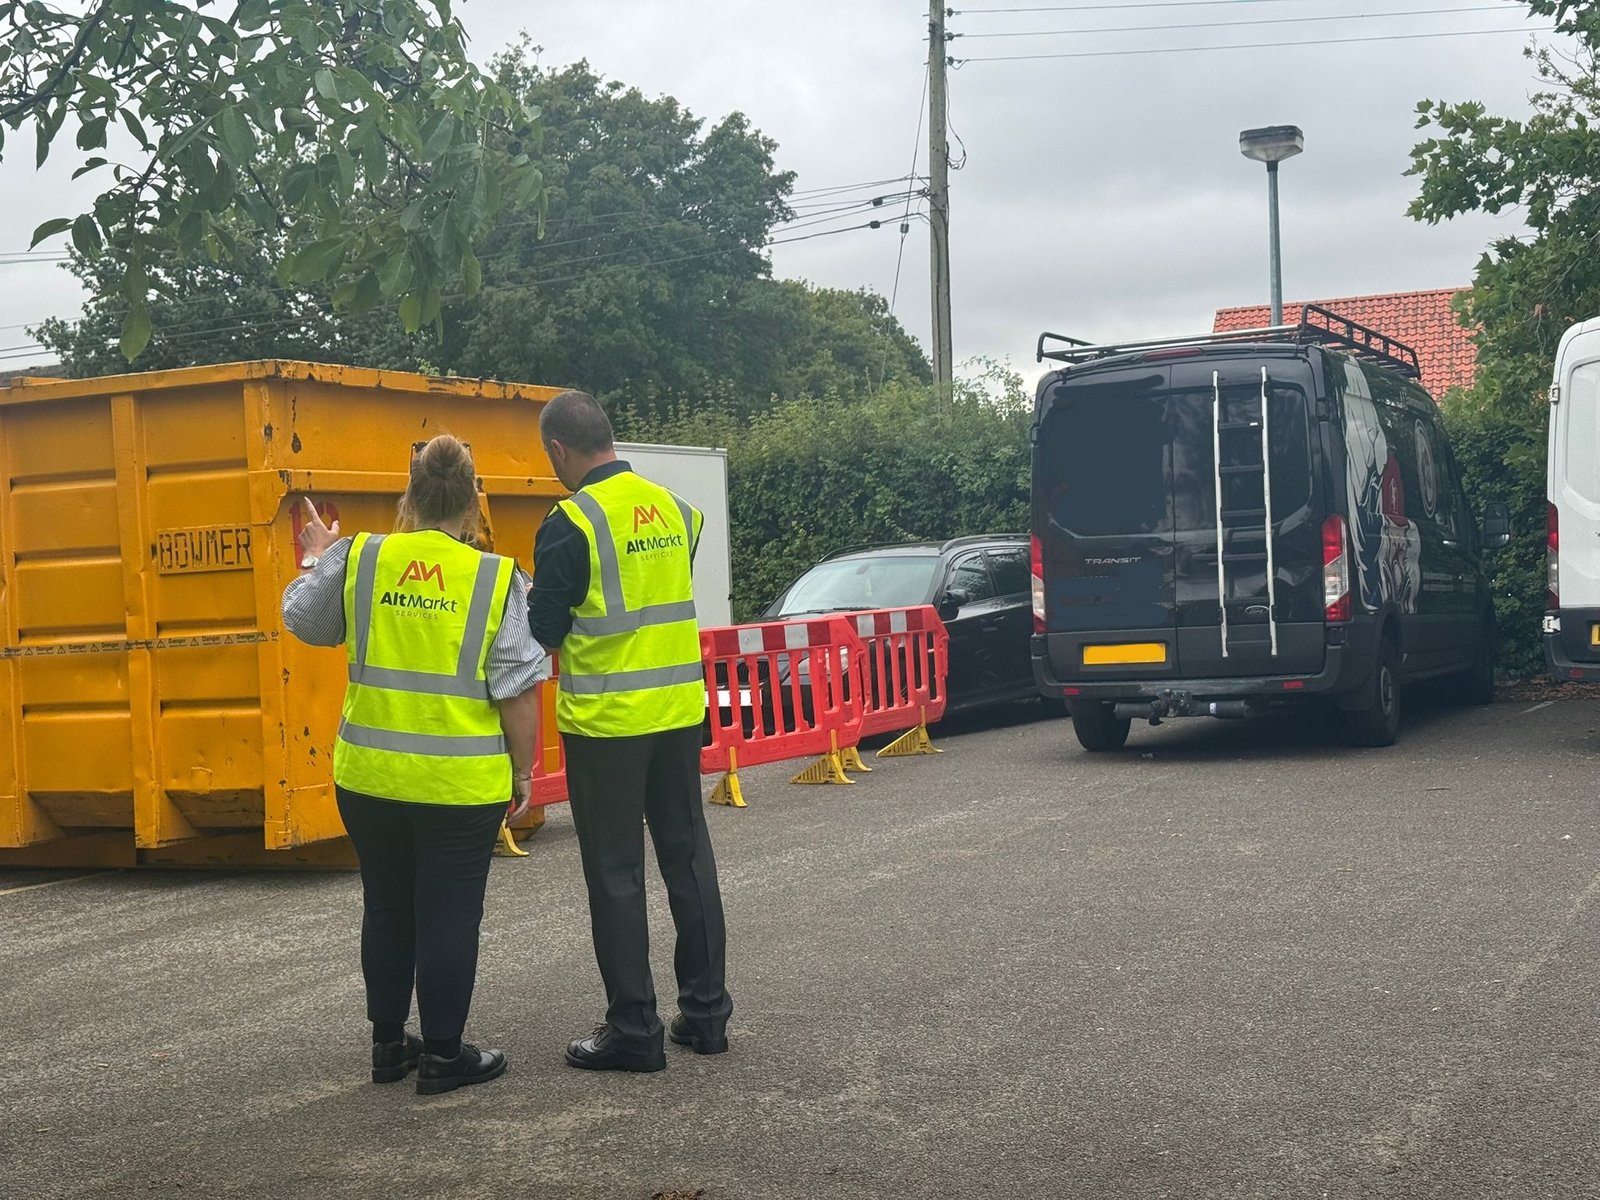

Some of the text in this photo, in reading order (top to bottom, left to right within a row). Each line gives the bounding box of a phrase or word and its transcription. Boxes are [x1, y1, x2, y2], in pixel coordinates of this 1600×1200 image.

[158, 528, 253, 570] BOWMER
[626, 534, 683, 555] AltMarkt
[1084, 556, 1142, 564] TRANSIT
[380, 591, 458, 613] AltMarkt
[394, 609, 438, 620] SERVICES
